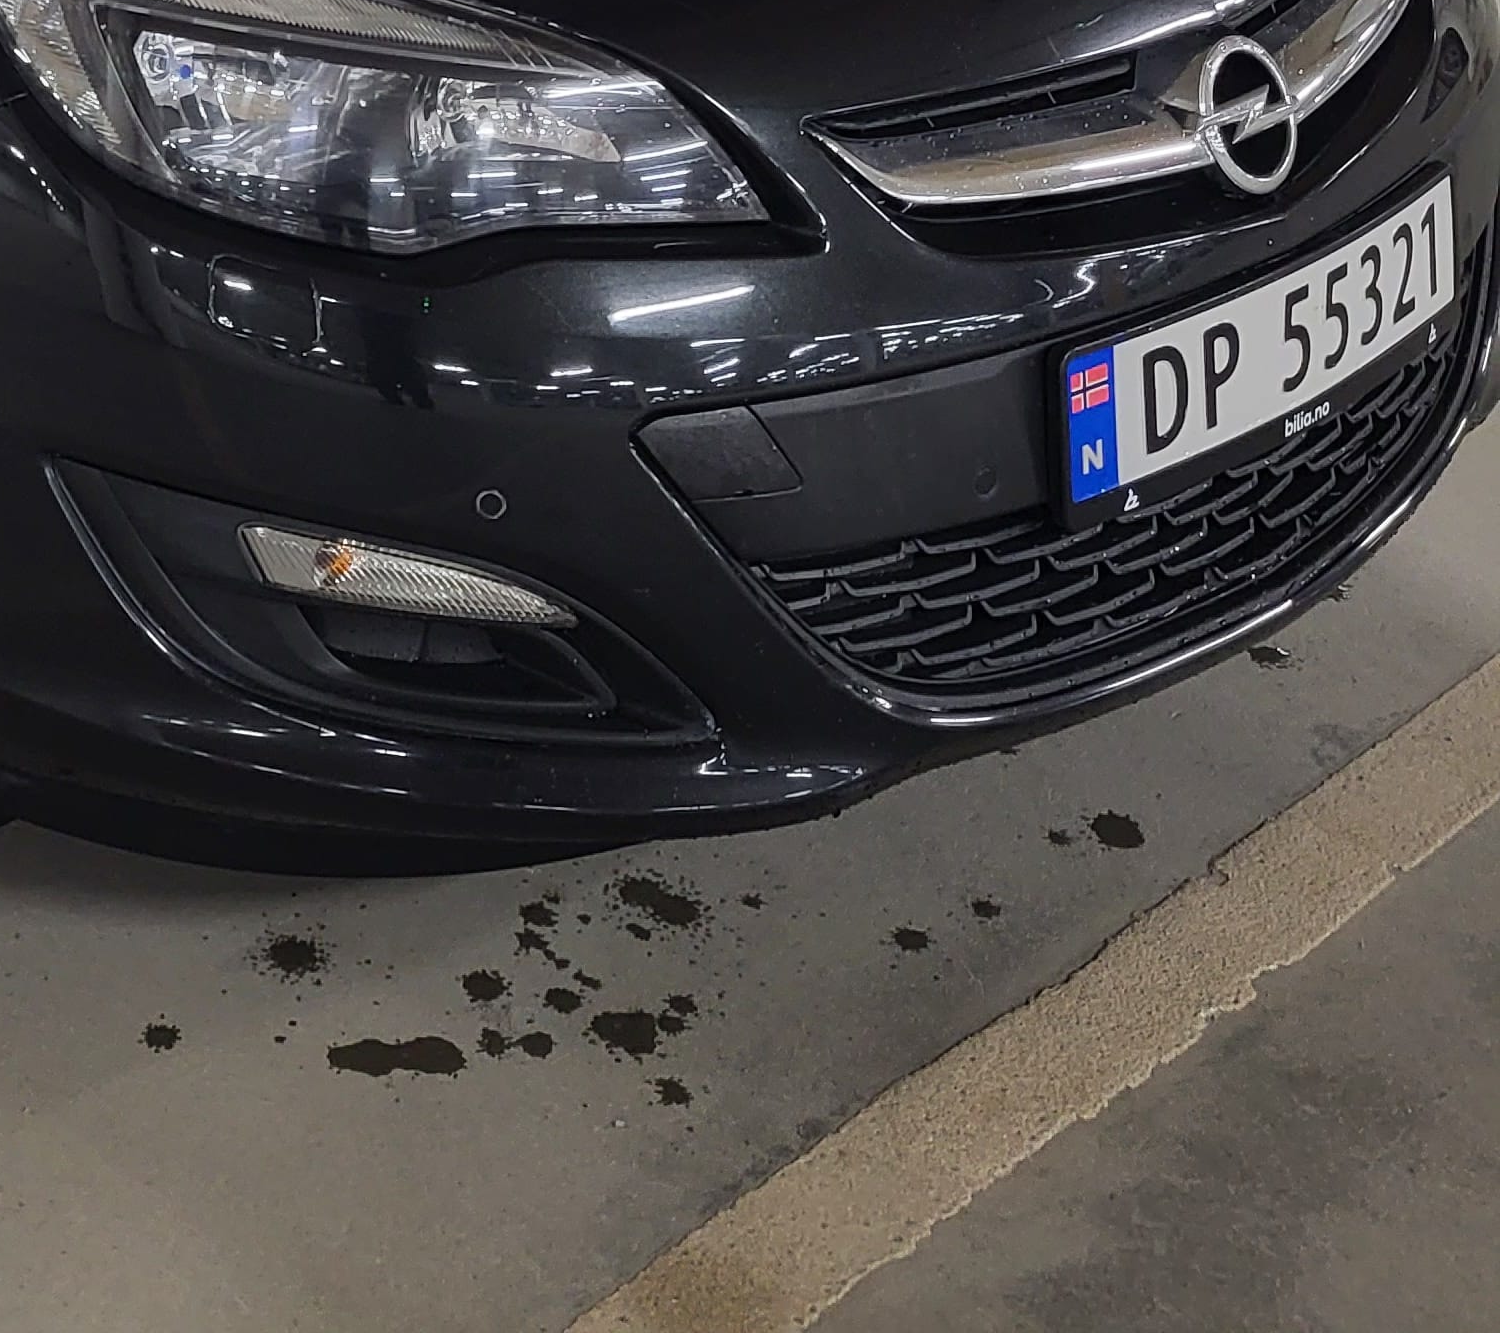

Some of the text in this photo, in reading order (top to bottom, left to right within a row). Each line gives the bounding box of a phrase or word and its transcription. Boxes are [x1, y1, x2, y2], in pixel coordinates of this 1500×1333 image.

[1142, 202, 1438, 454] DP 55321
[1284, 401, 1330, 438] bilia.no
[1081, 439, 1104, 475] N
